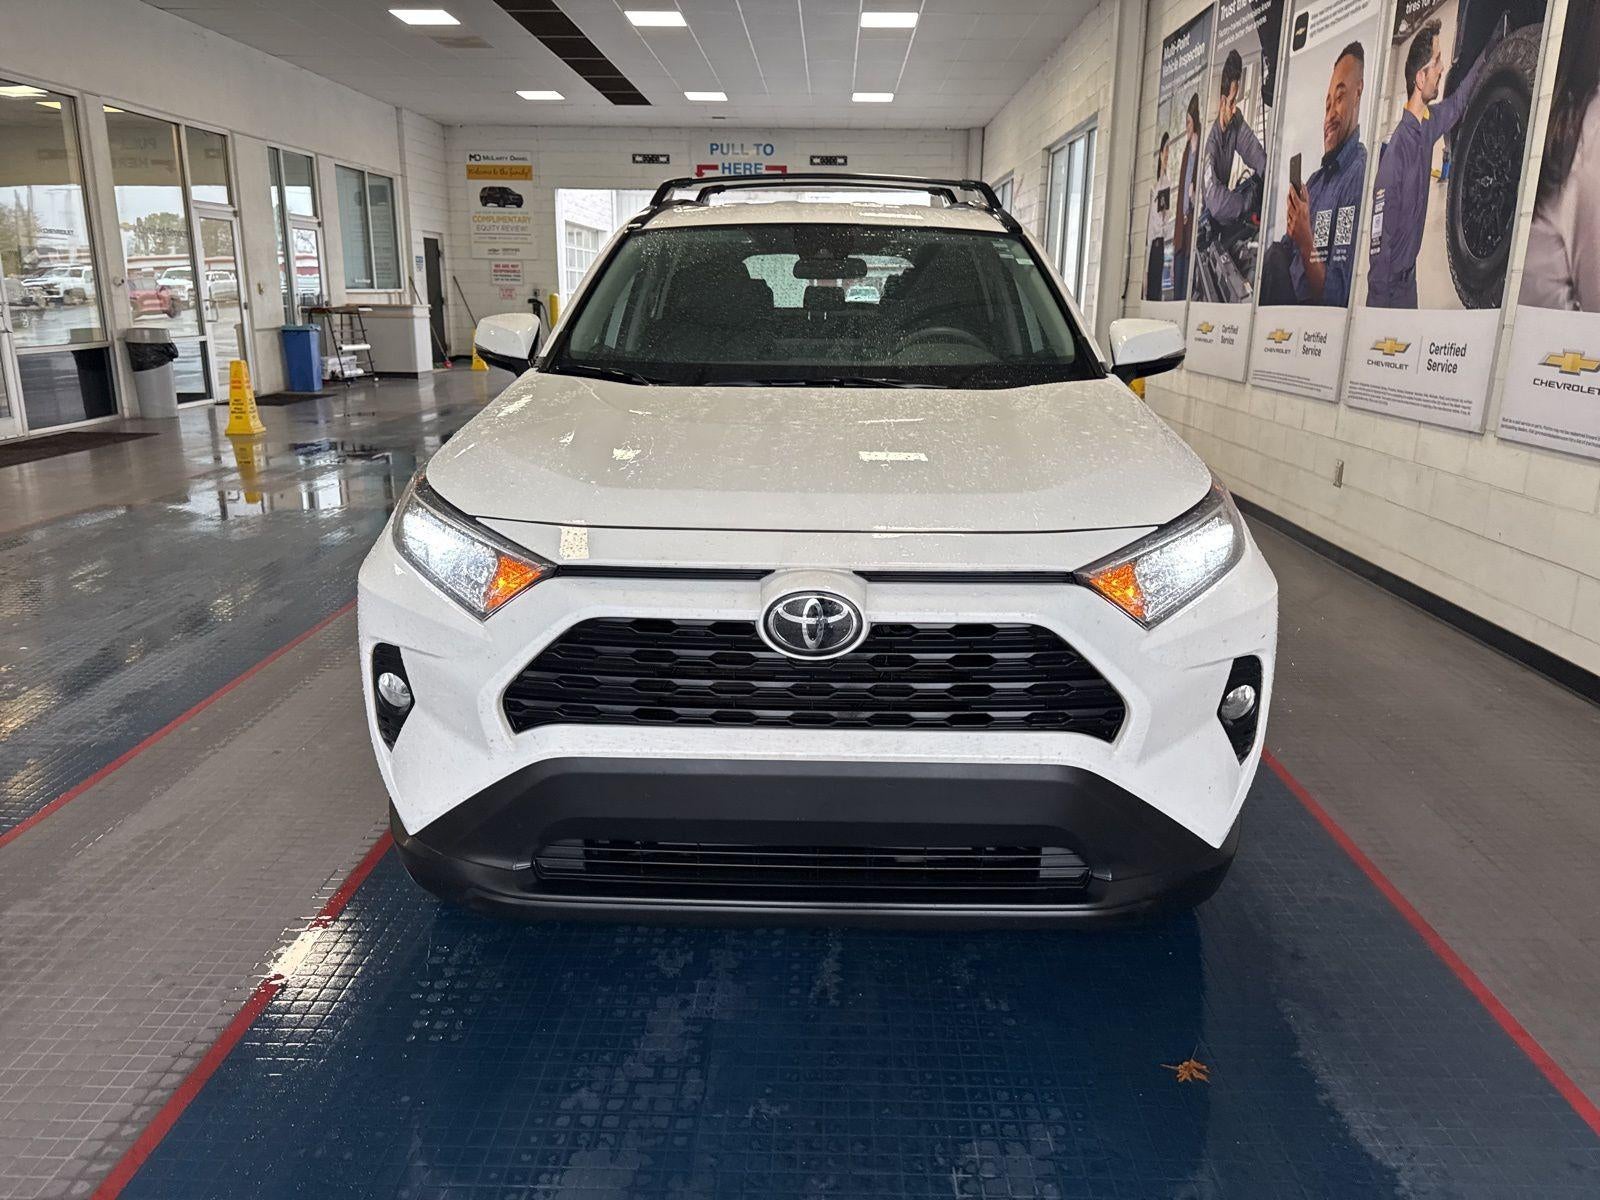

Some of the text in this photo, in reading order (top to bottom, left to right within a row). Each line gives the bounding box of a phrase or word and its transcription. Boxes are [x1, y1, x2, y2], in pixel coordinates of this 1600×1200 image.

[1221, 0, 1237, 21] Trust
[1164, 31, 1190, 60] Multi-Point
[1162, 57, 1179, 78] Vehicle
[1179, 41, 1206, 68] Inspection
[709, 143, 774, 156] PULL TO
[721, 162, 763, 175] HERE
[472, 215, 531, 223] COMPLIMENTARY
[476, 224, 500, 232] EQUITY
[1221, 324, 1239, 335] Certified
[1220, 334, 1235, 346] Service
[1303, 331, 1328, 344] Certified
[1302, 344, 1322, 357] Service
[1428, 341, 1468, 358] Certified
[1366, 359, 1409, 370] CHEVROLET
[1426, 358, 1458, 374] Service
